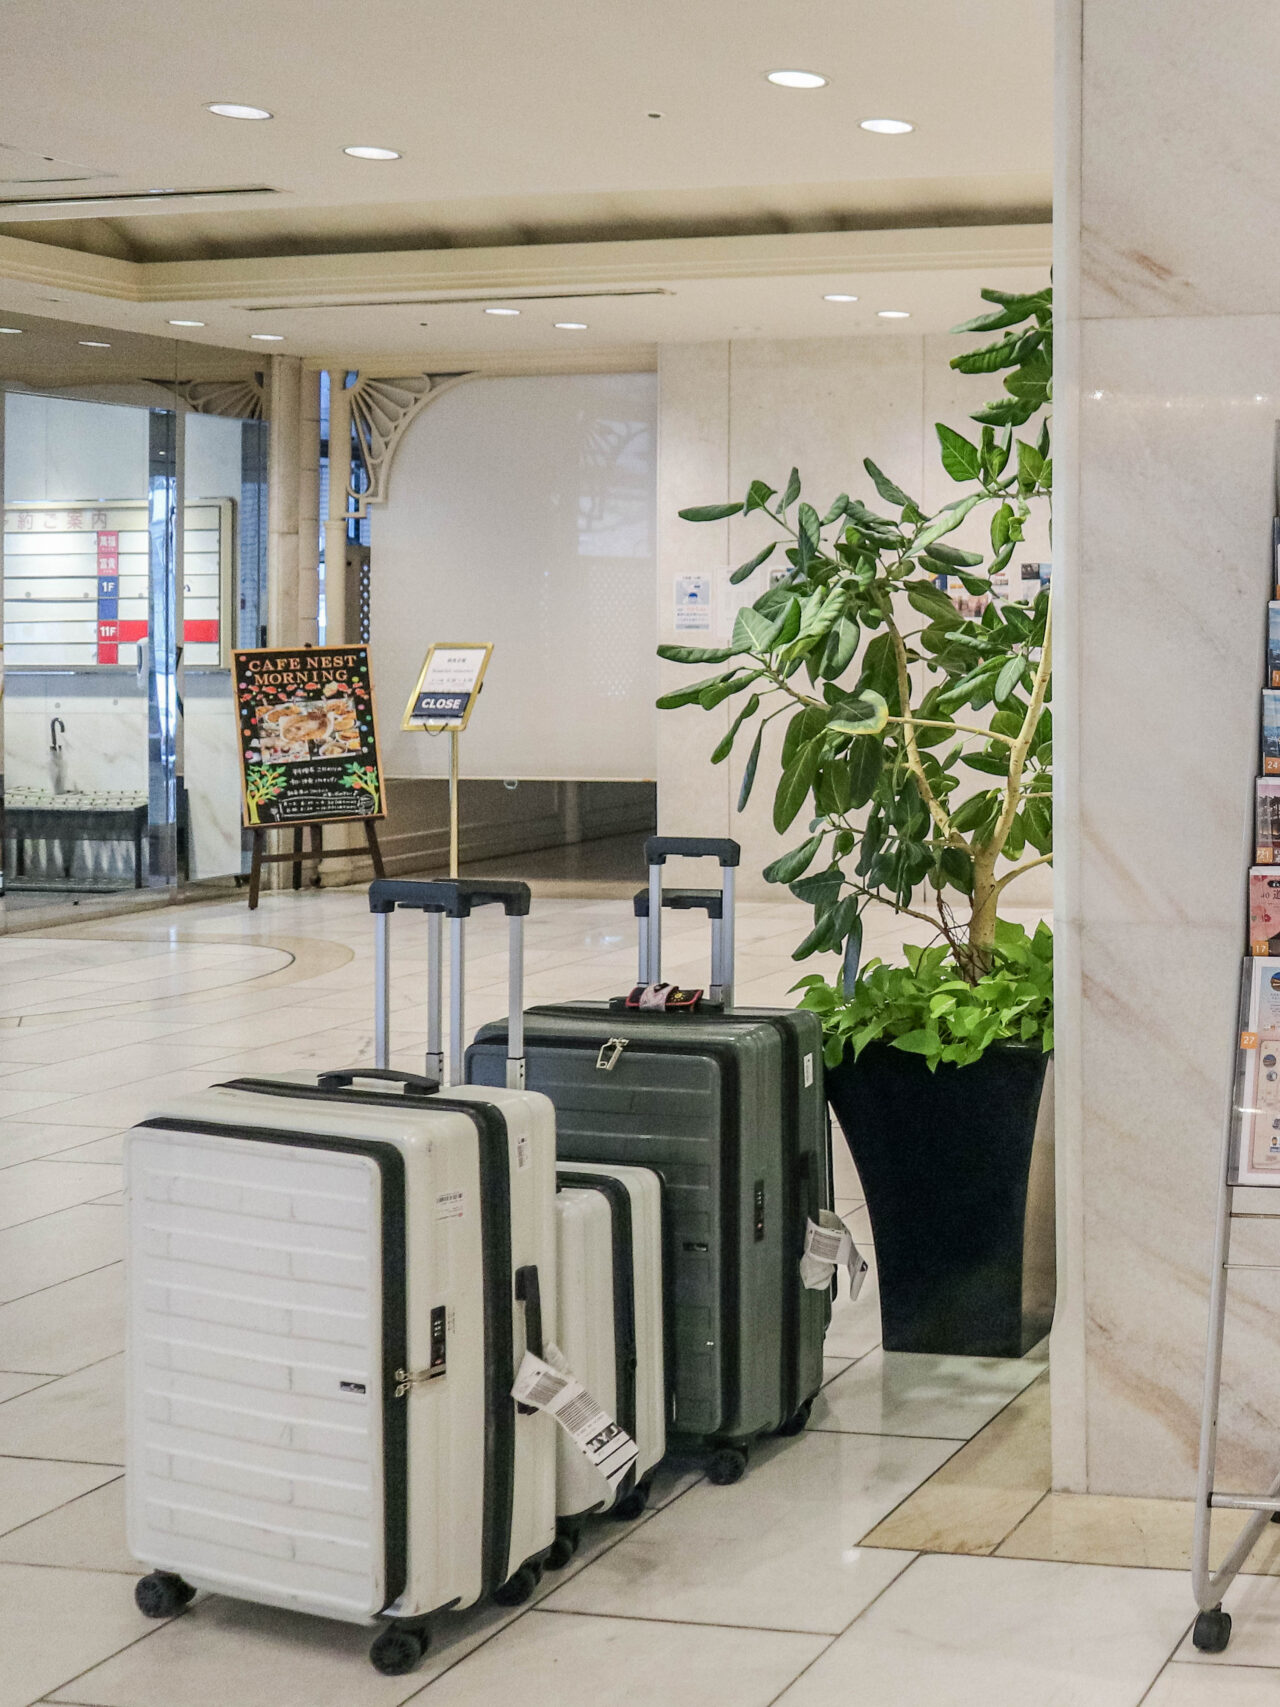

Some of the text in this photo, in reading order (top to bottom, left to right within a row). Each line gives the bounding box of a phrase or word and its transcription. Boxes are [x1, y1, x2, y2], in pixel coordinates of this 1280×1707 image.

[4, 511, 107, 530] 約ご案内
[102, 581, 115, 592] 1F
[100, 626, 117, 637] 11F
[248, 655, 357, 672] CAFE NEST
[254, 669, 348, 685] MORNING
[421, 698, 462, 709] CLOSE
